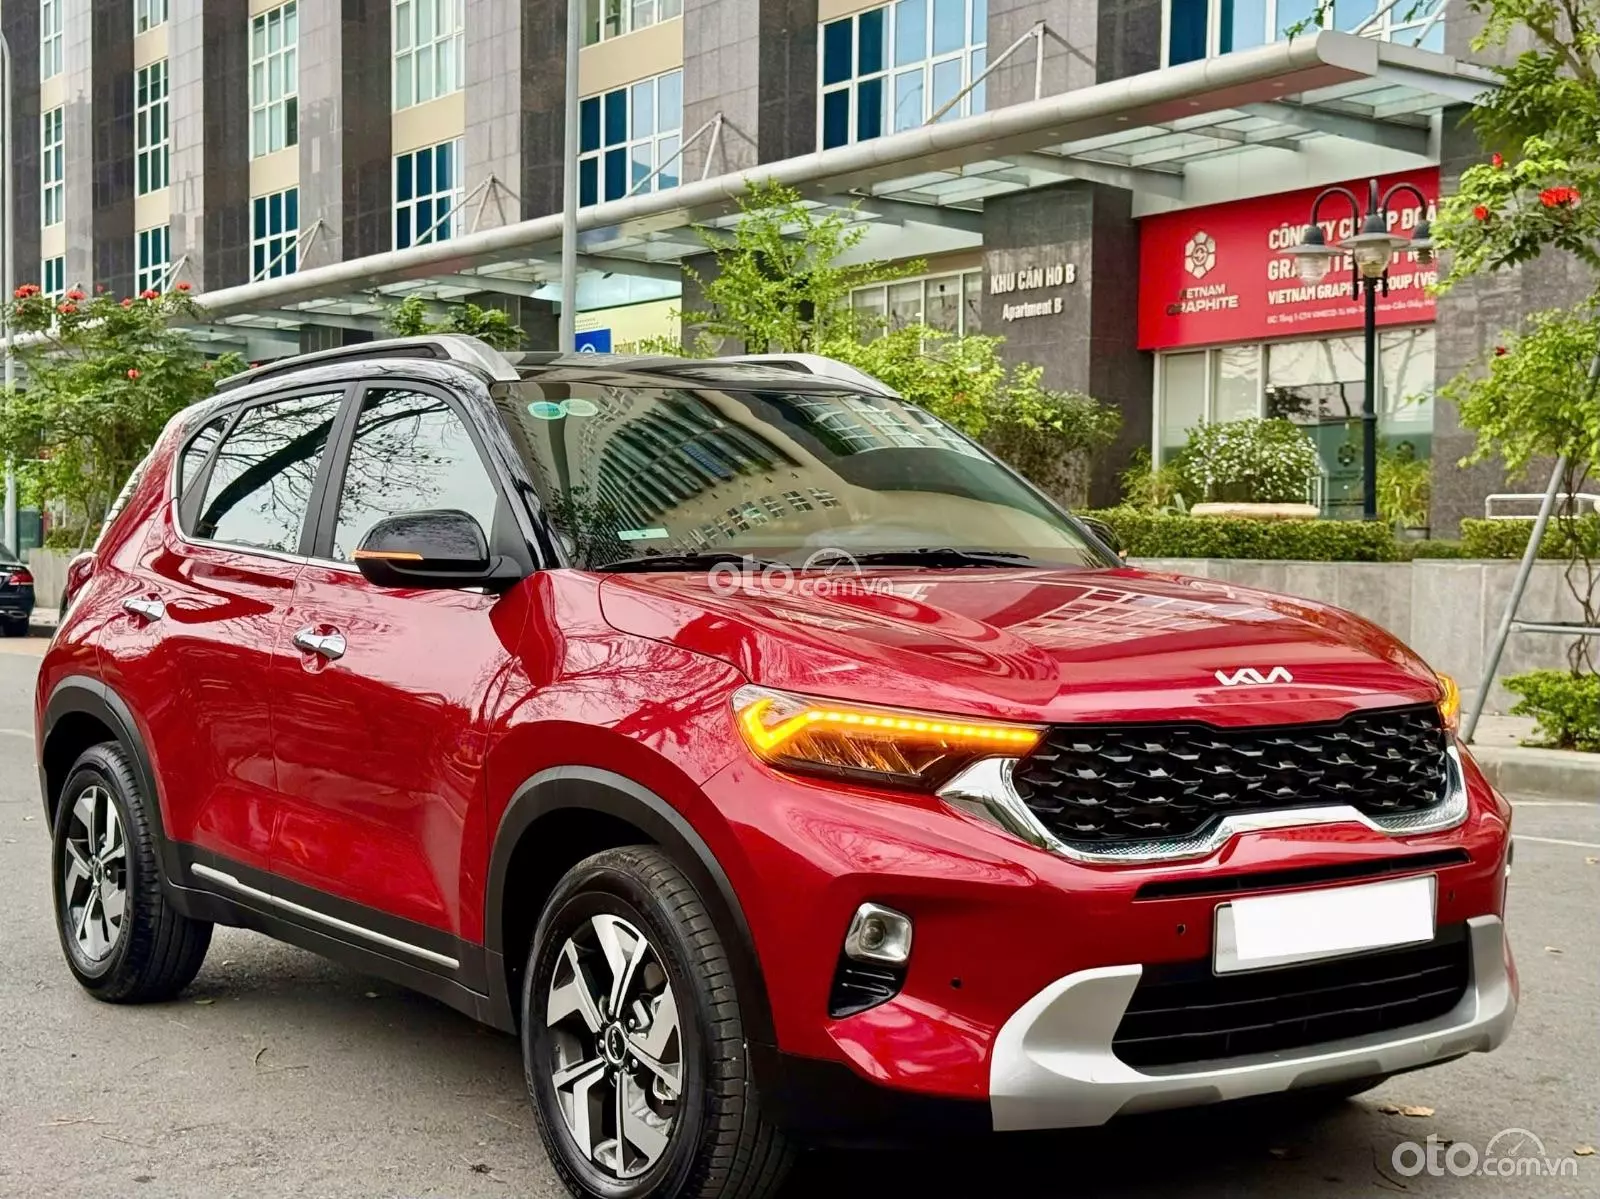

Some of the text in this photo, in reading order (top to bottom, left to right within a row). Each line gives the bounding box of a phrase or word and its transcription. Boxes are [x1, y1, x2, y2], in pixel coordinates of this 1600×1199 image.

[991, 272, 1015, 295] KHU
[1065, 263, 1075, 284] B
[1268, 285, 1315, 305] VIETNAM
[1002, 297, 1062, 322] Apartment B
